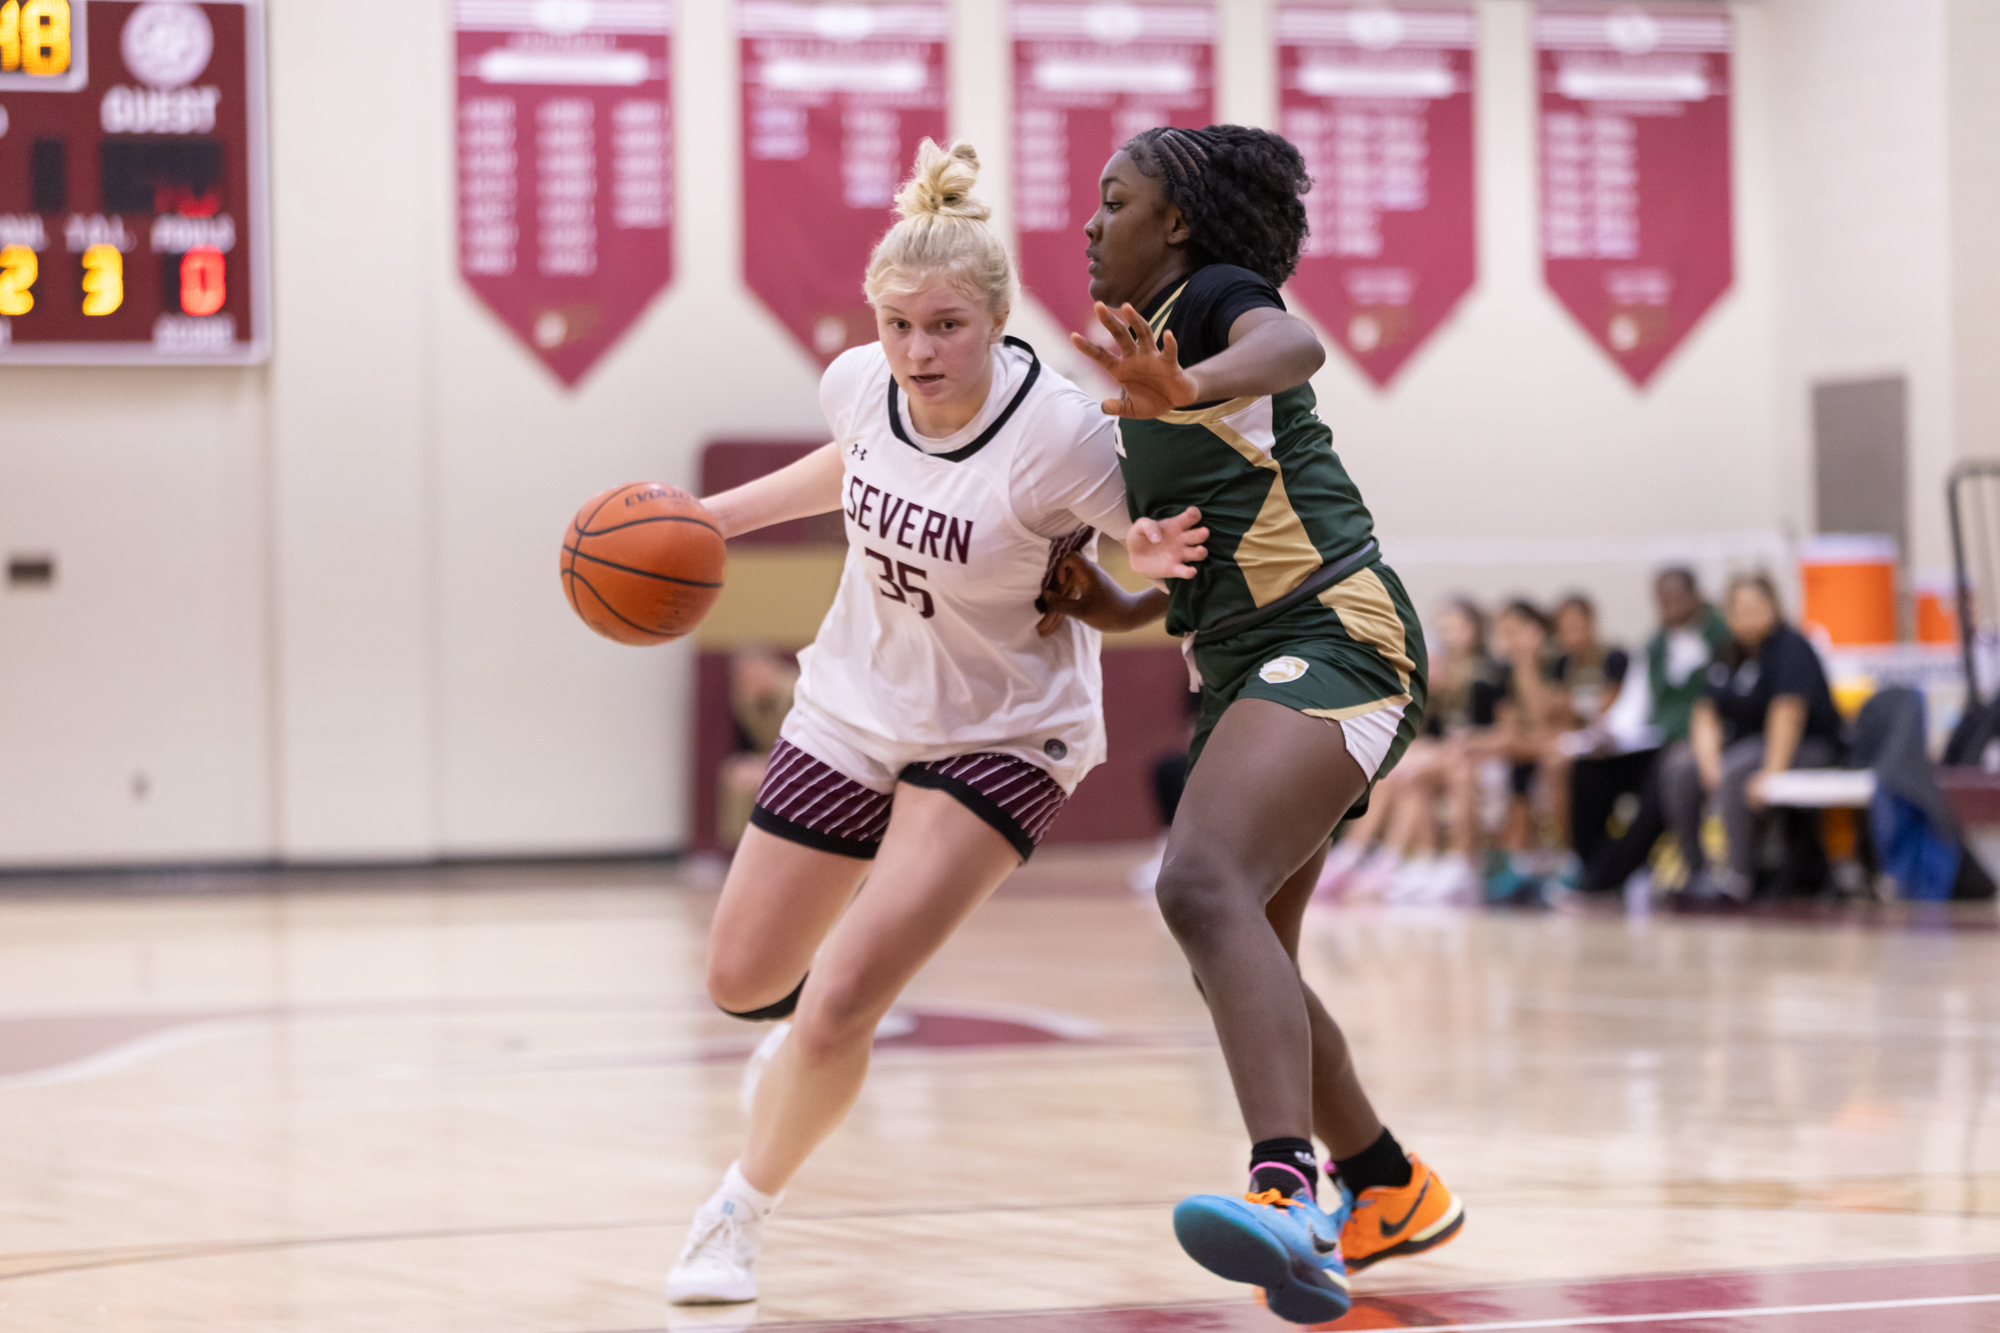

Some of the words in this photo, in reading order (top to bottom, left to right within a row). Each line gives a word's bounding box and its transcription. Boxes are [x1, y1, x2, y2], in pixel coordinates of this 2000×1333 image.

[101, 85, 220, 134] GUEST
[0, 244, 38, 316] 2
[82, 244, 124, 316] 3
[180, 246, 226, 316] 0
[846, 475, 974, 565] SEVERN
[864, 546, 936, 620] 35
